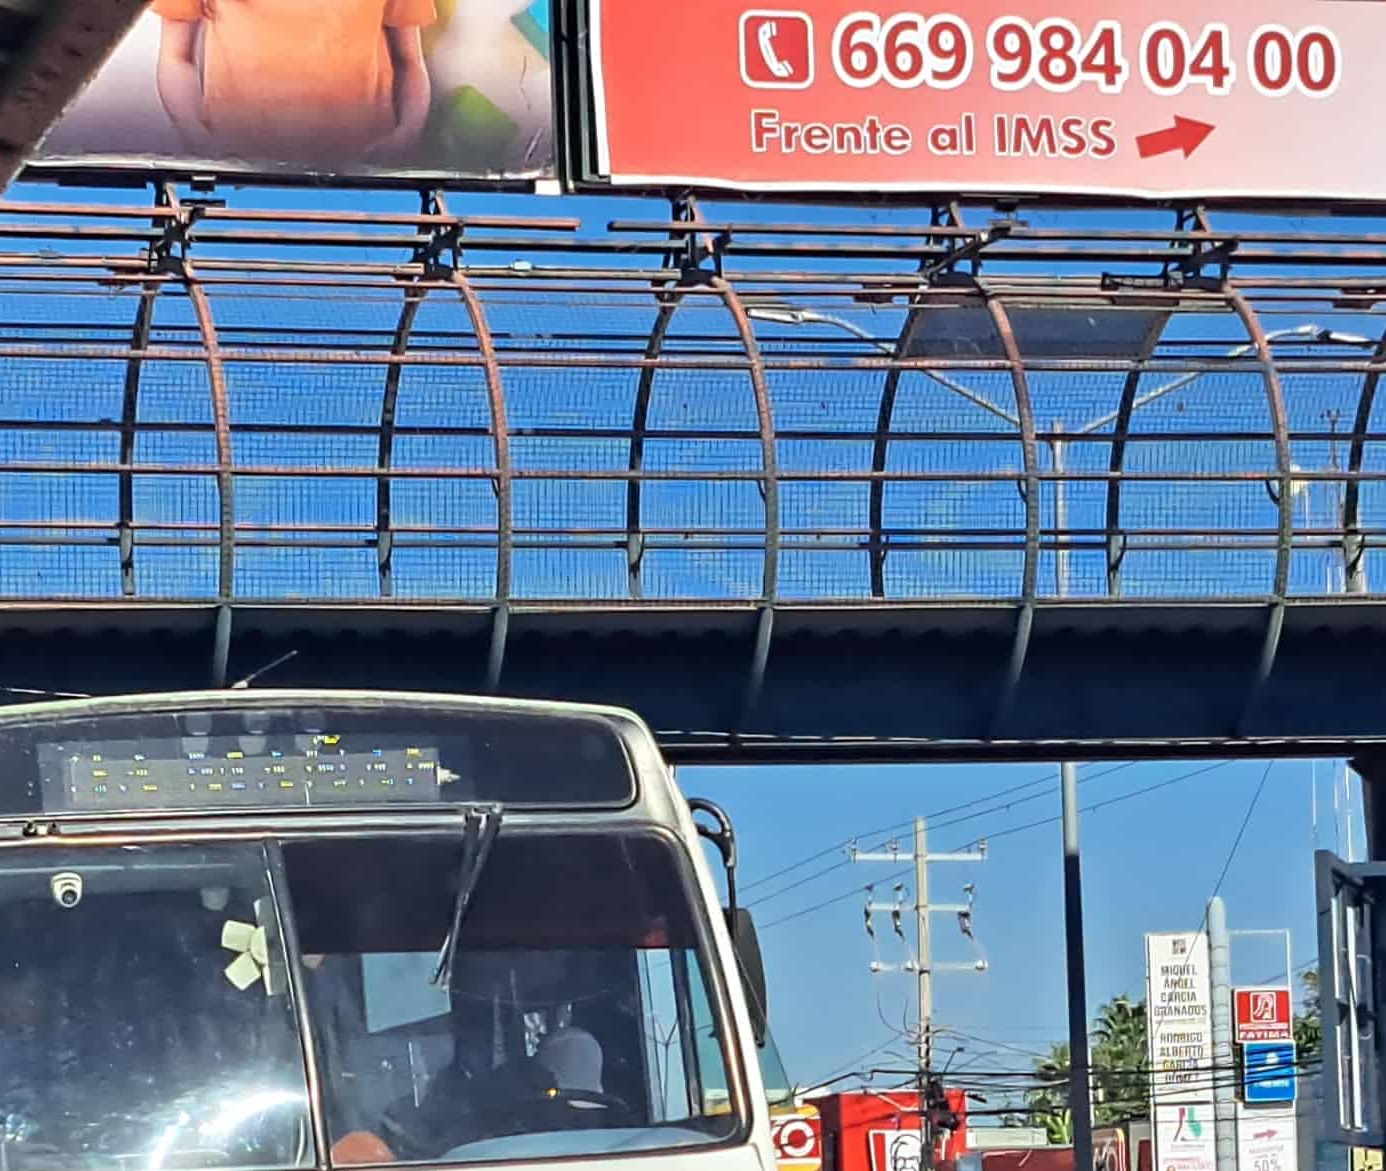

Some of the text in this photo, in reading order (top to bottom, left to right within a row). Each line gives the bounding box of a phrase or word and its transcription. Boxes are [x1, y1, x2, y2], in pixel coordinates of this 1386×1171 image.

[835, 17, 1340, 94] 669 984 04 00
[751, 112, 1117, 158] Frente al IMSS
